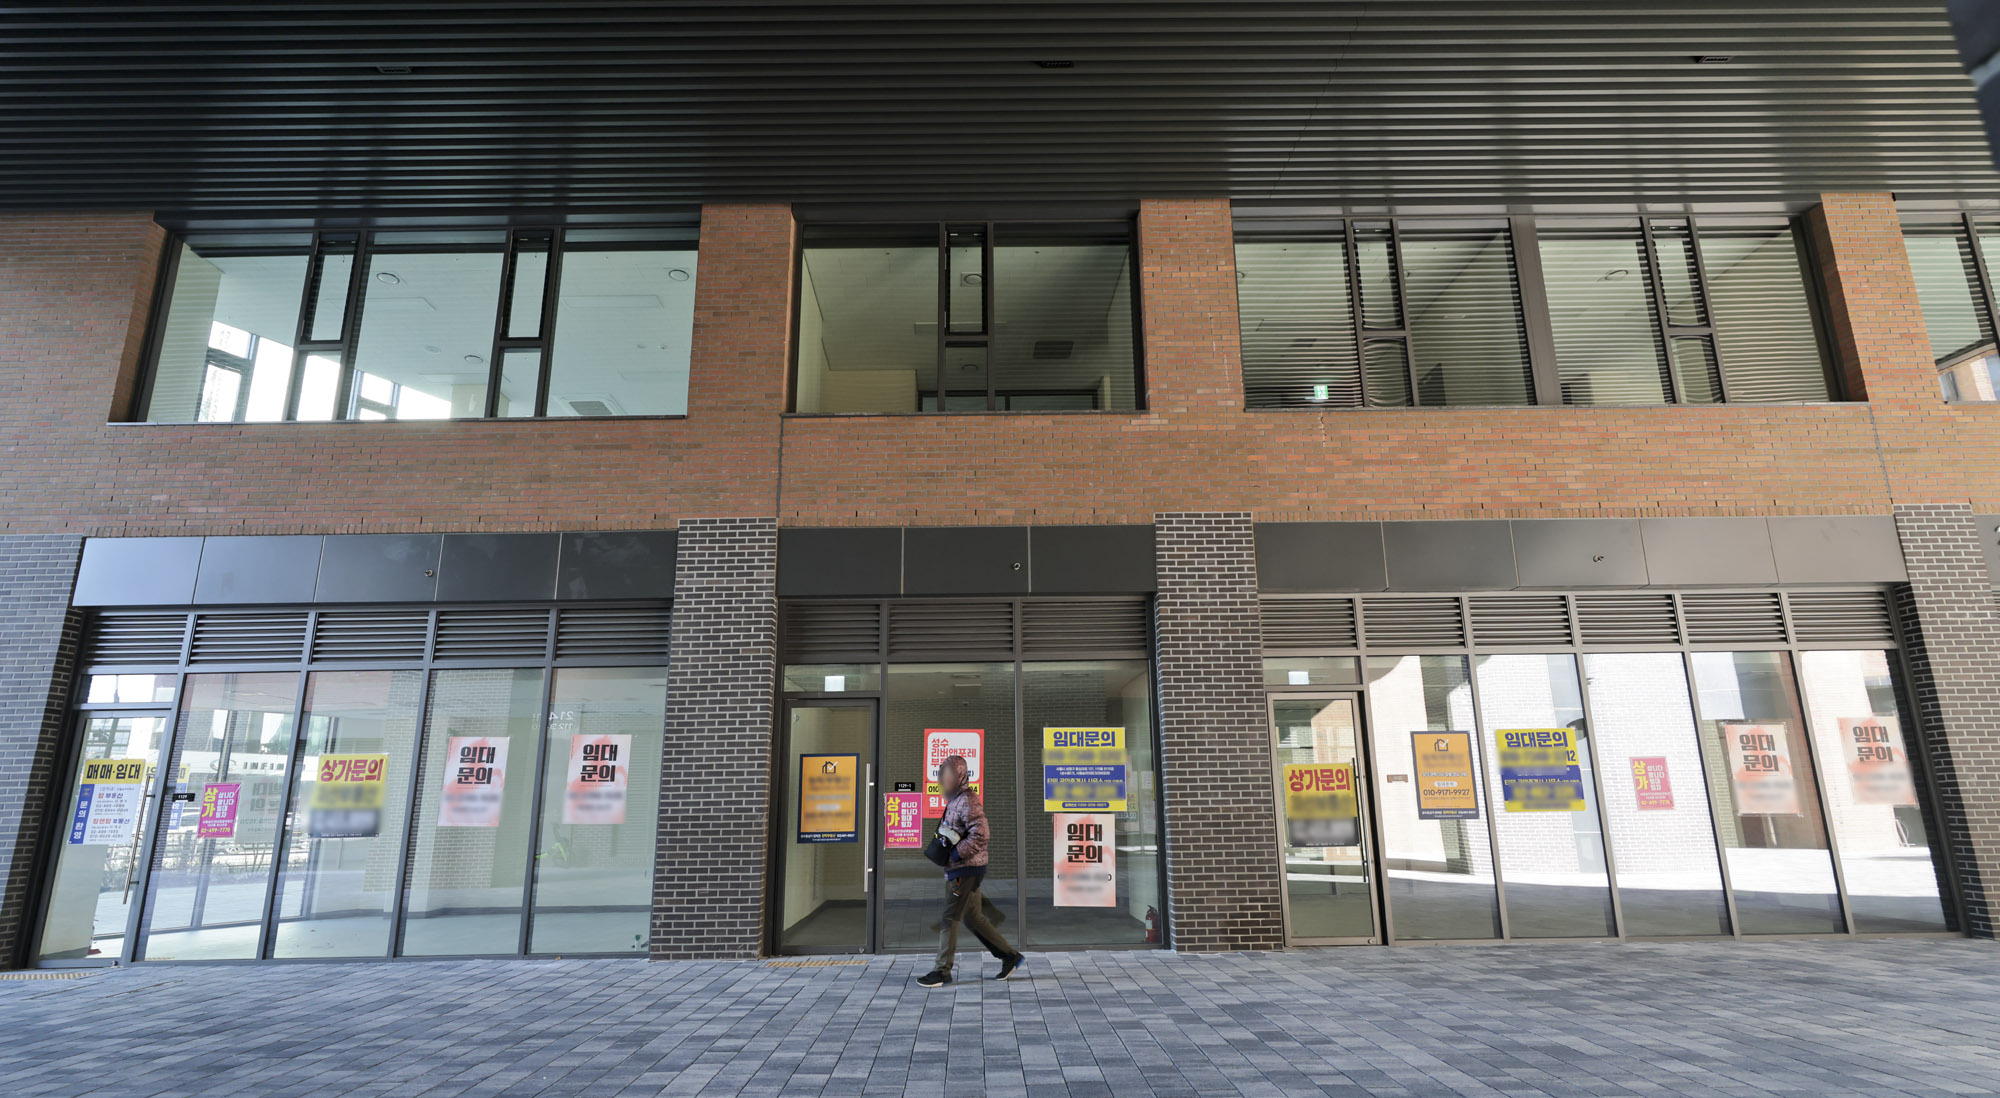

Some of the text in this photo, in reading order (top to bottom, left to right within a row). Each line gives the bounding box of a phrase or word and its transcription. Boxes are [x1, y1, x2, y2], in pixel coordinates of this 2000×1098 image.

[932, 738, 948, 748] 성수
[1053, 731, 1116, 747] 임대문의
[1504, 732, 1568, 748] 임대문의
[1740, 734, 1774, 752] 임대
[1852, 726, 1888, 743] 임대
[460, 746, 496, 764] 임대
[582, 744, 618, 762] 임대
[321, 759, 384, 782] 상가문의
[1743, 755, 1778, 772] 문의
[456, 767, 492, 785] 문의
[580, 765, 615, 782] 문의
[1289, 768, 1350, 792] 상가문의
[201, 787, 218, 818] 상가
[887, 797, 900, 827] 상가
[1066, 823, 1102, 842] 임대
[1066, 845, 1103, 864] 문의
